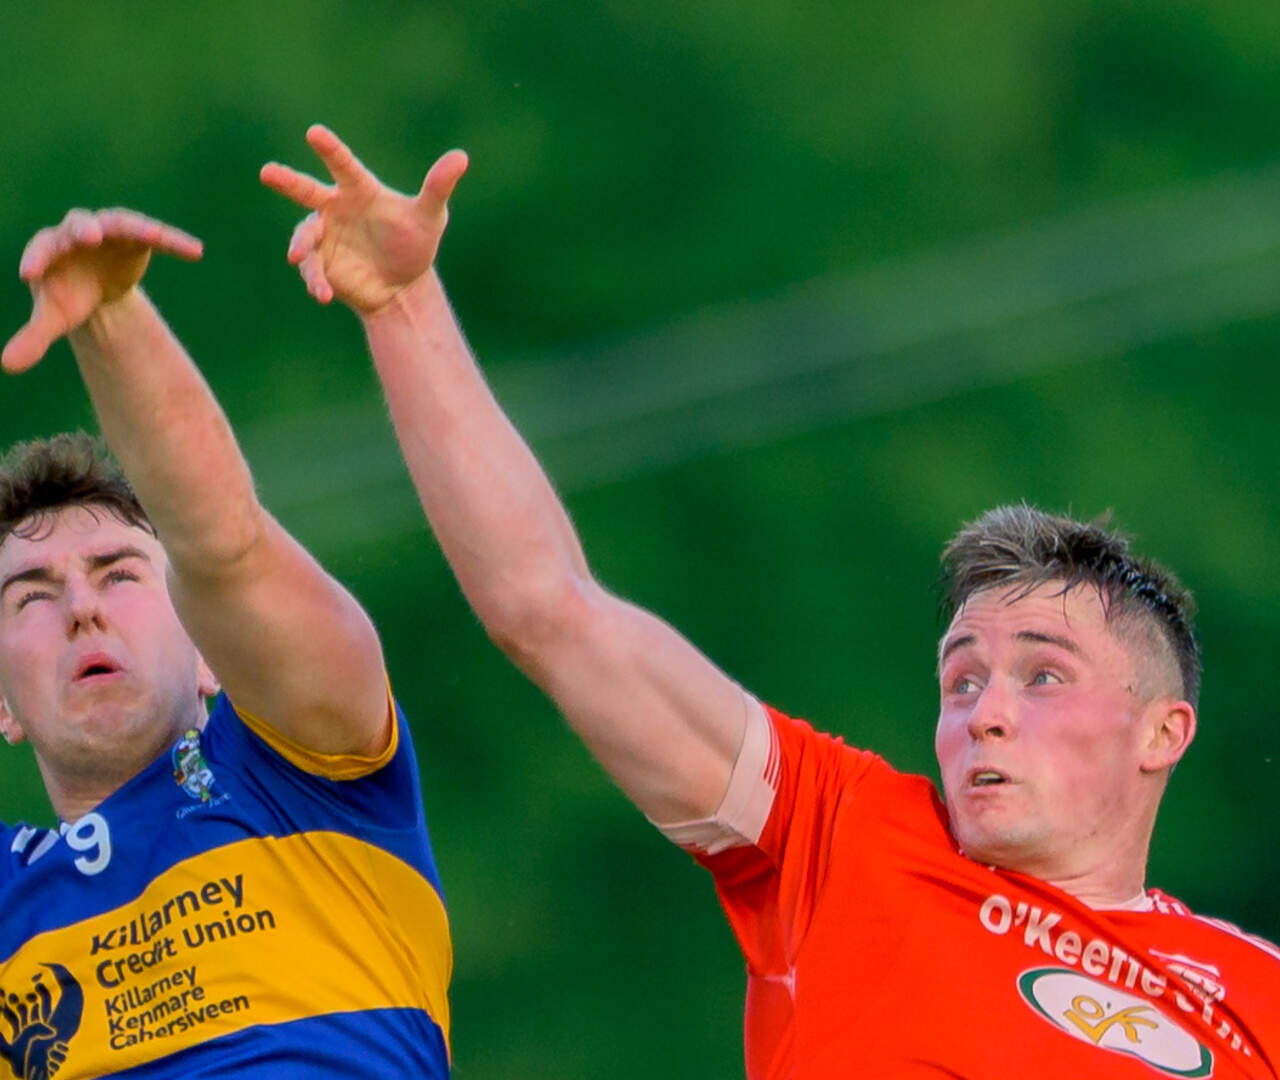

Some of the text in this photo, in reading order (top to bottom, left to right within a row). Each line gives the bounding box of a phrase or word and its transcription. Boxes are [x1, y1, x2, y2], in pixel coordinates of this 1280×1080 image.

[65, 811, 111, 876] 9
[90, 874, 244, 956] Killarney
[96, 910, 276, 989] Credit Union
[104, 966, 197, 1017] Killarney
[108, 985, 205, 1035] Kenmare
[109, 994, 250, 1051] Cahersiveen
